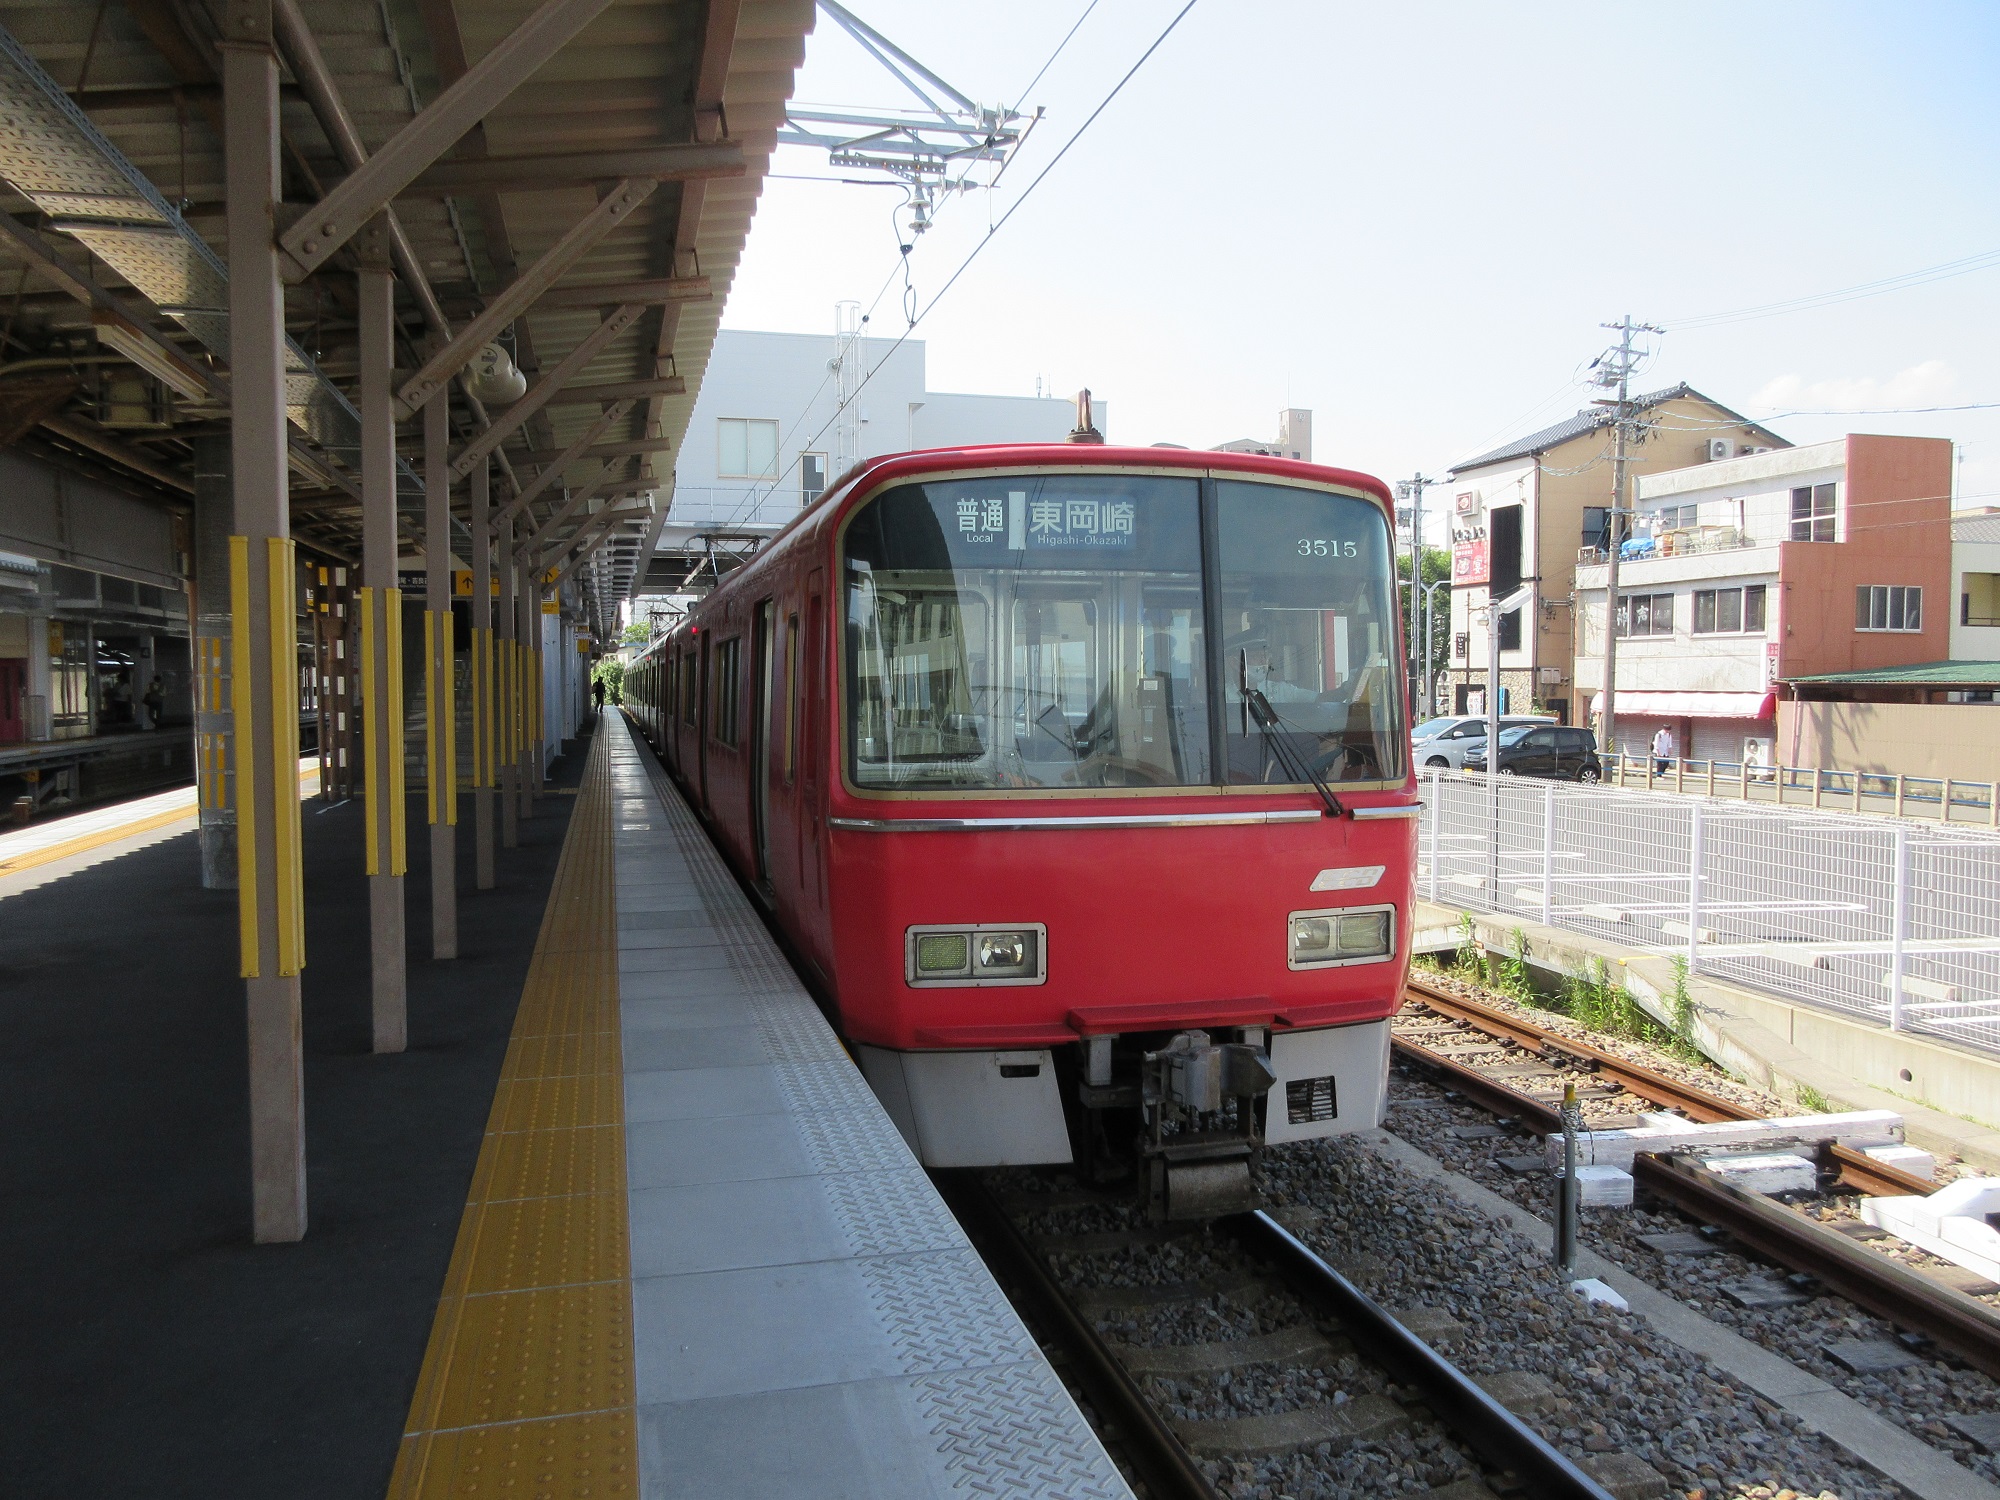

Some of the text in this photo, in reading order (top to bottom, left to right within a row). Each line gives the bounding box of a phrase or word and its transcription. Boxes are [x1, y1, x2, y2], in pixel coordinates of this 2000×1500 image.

[956, 498, 1004, 533] 普通
[1029, 500, 1135, 535] 東岡崎
[966, 533, 994, 543] Local
[1037, 534, 1128, 547] Higashi-Okazaki
[1297, 538, 1358, 558] 3515
